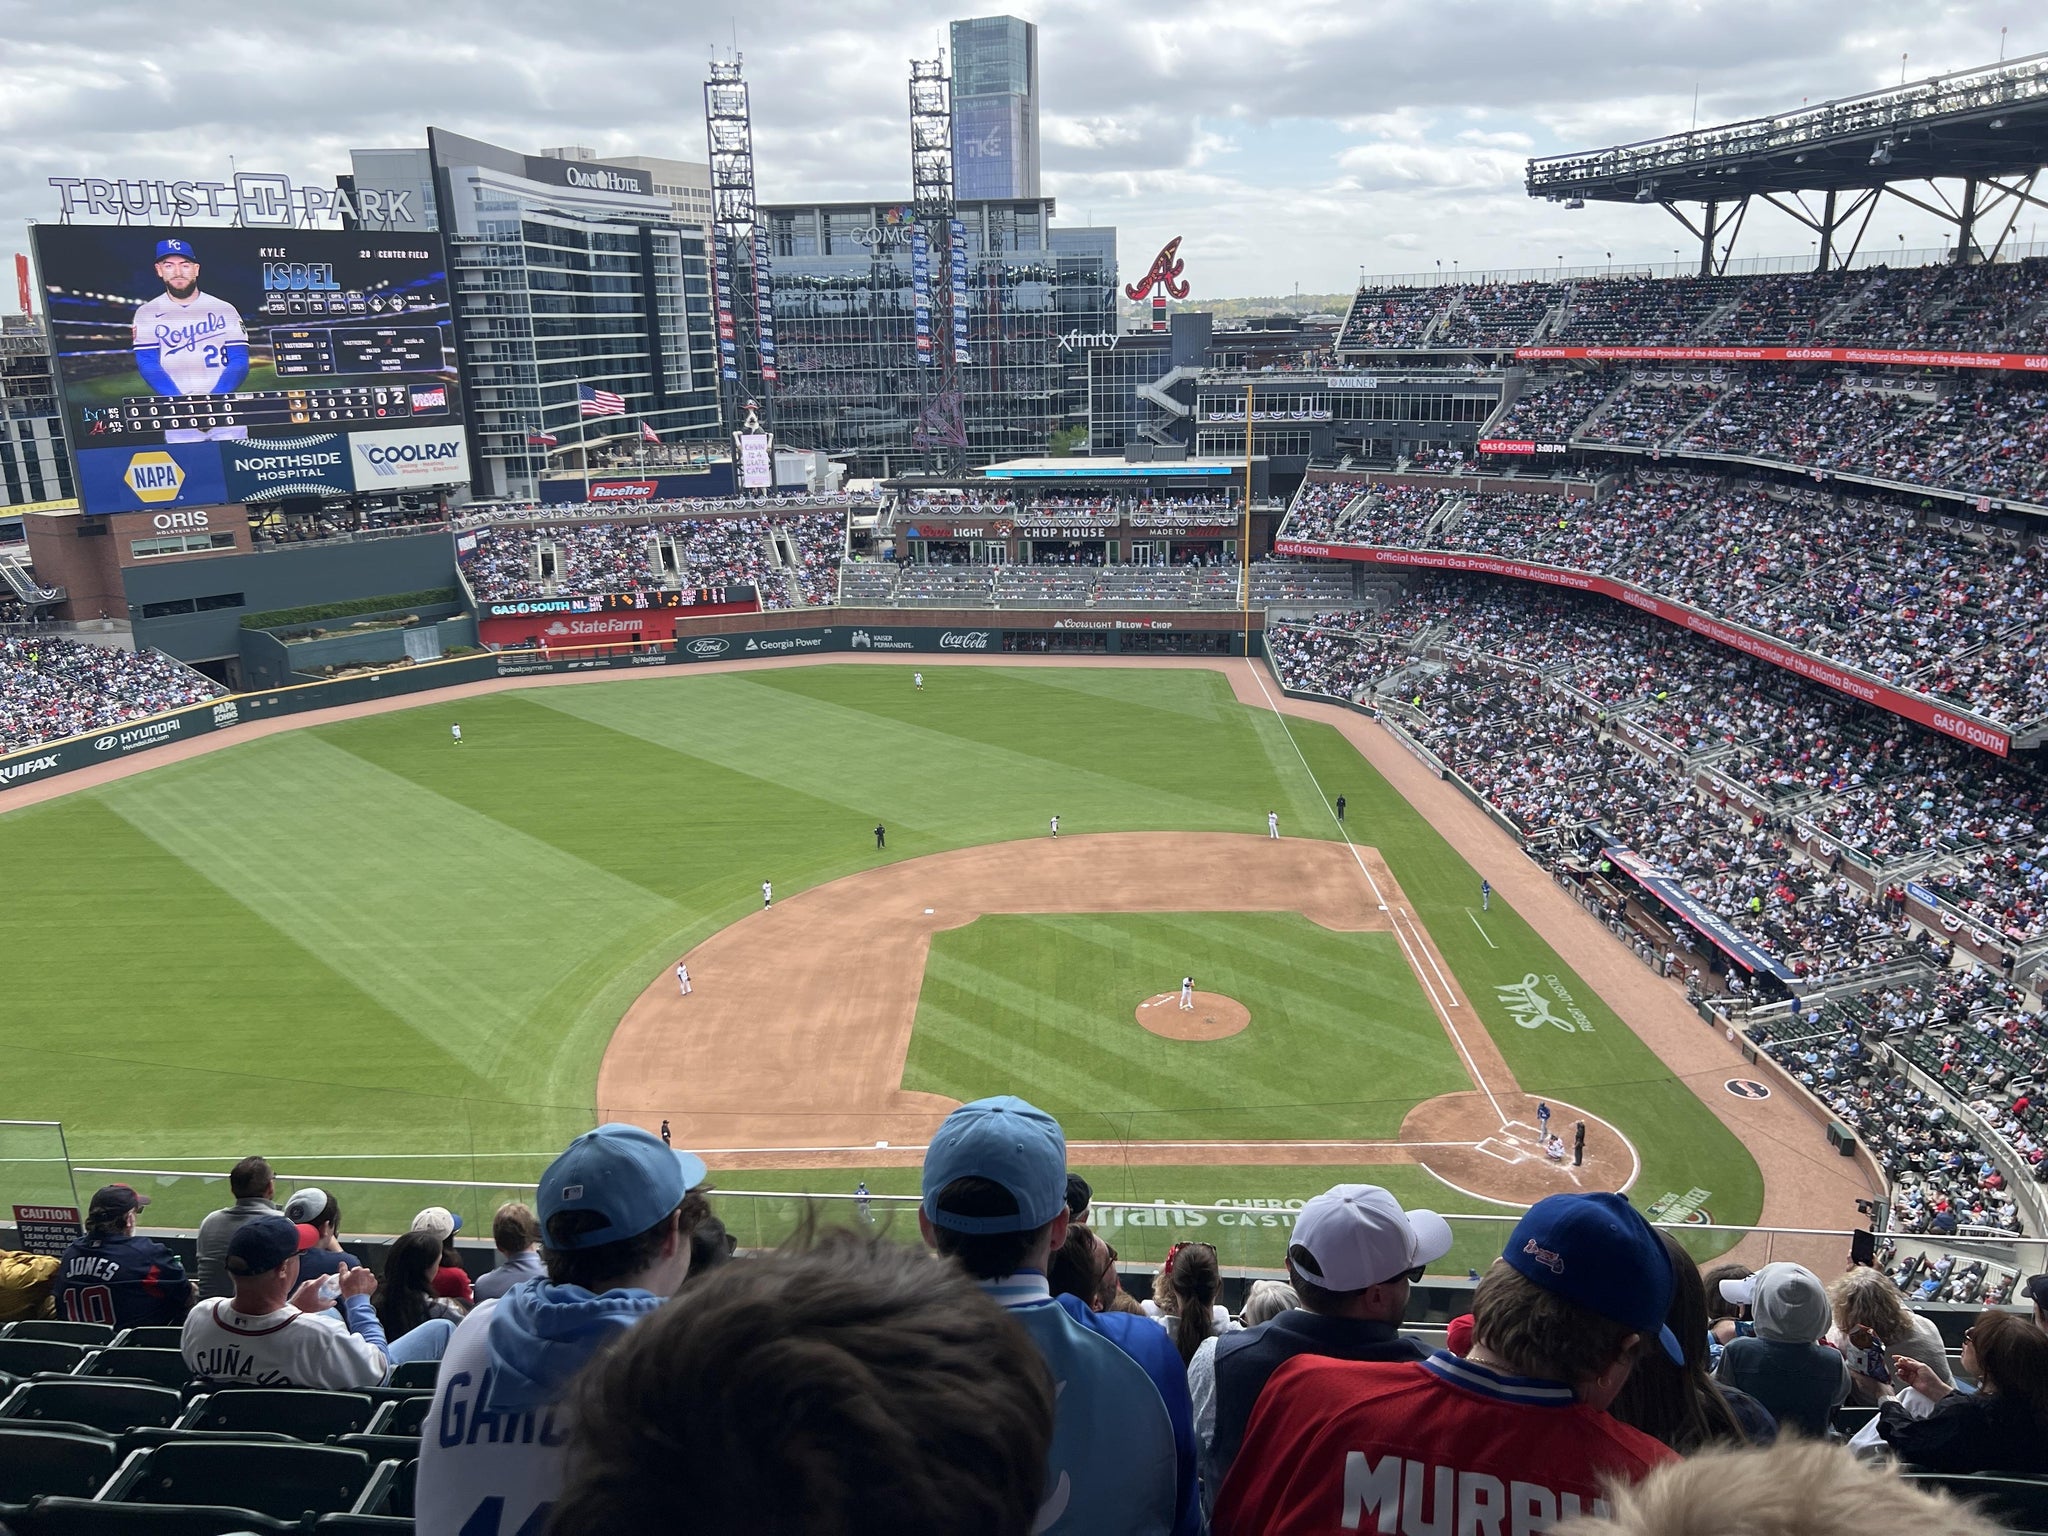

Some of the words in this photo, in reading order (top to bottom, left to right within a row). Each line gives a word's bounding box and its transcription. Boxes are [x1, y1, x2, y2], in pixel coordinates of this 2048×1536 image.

[48, 178, 225, 216] TRUIST
[302, 186, 415, 222] PARK
[851, 226, 912, 244] COMC
[168, 240, 180, 250] KC
[260, 248, 286, 257] KYLE
[263, 262, 340, 290] ISBEL
[155, 312, 226, 352] Royals
[1058, 329, 1120, 352] xfinity
[203, 345, 229, 368] 28
[1903, 354, 1929, 362] Provider
[1950, 355, 1975, 365] Atlanta
[1338, 378, 1375, 388] MILNER
[377, 393, 387, 405] 0
[394, 392, 404, 404] 2
[414, 399, 446, 407] VISION
[132, 408, 139, 416] 0
[312, 399, 319, 407] 5
[134, 422, 142, 430] 0
[313, 412, 320, 420] 4
[330, 411, 337, 419] 0
[369, 442, 460, 464] COOLRAY
[1653, 449, 1659, 460] 3
[235, 452, 342, 472] NORTHSIDE
[134, 466, 177, 488] NAPA
[258, 468, 325, 481] HOSPITAL
[593, 486, 650, 497] RaceTrac
[1977, 497, 1990, 512] 10
[154, 511, 208, 529] ORIS
[920, 525, 951, 537] Coors
[954, 528, 984, 537] LIGHT
[1024, 529, 1058, 537] CHOP
[1063, 528, 1105, 537] HOUSE
[1278, 544, 1293, 552] GAS
[1302, 546, 1329, 555] SOUTH
[1376, 552, 1409, 562] Official
[1410, 555, 1445, 566] Natural
[1448, 558, 1466, 568] Gas
[1468, 559, 1501, 572] Provider
[1505, 565, 1513, 574] of
[1514, 566, 1527, 577] the
[1528, 568, 1558, 582] Atlanta
[492, 605, 516, 615] GAS
[531, 602, 570, 612] SOUTH
[573, 601, 587, 609] NL
[571, 621, 607, 634] State
[608, 619, 643, 632] Farm
[1064, 618, 1089, 628] Coors
[1152, 621, 1172, 629] CHOP
[695, 640, 722, 652] Ford
[760, 639, 794, 650] Georgia
[796, 638, 822, 646] Power
[1688, 616, 1710, 633] Official
[1712, 625, 1736, 644] Natural
[1737, 637, 1751, 649] Gas
[1751, 642, 1783, 664] Provider
[1785, 656, 1794, 668] of
[1795, 660, 1808, 673] the
[1809, 665, 1841, 686] Atlanta
[212, 701, 237, 715] PAPA
[214, 711, 238, 722] JOHNS
[120, 719, 180, 744] HYUNDAI
[1934, 714, 1954, 731] GAS
[1968, 729, 2004, 752] SOUTH
[123, 734, 169, 751] HyundaiUSA.com
[1912, 886, 1933, 902] GEICO
[1493, 973, 1575, 1032] SAIA
[20, 1208, 72, 1220] CAUTION
[1218, 1214, 1300, 1227] CASI
[66, 1257, 120, 1281] JONES
[64, 1285, 117, 1325] 10
[1341, 1451, 1612, 1536] MURP
